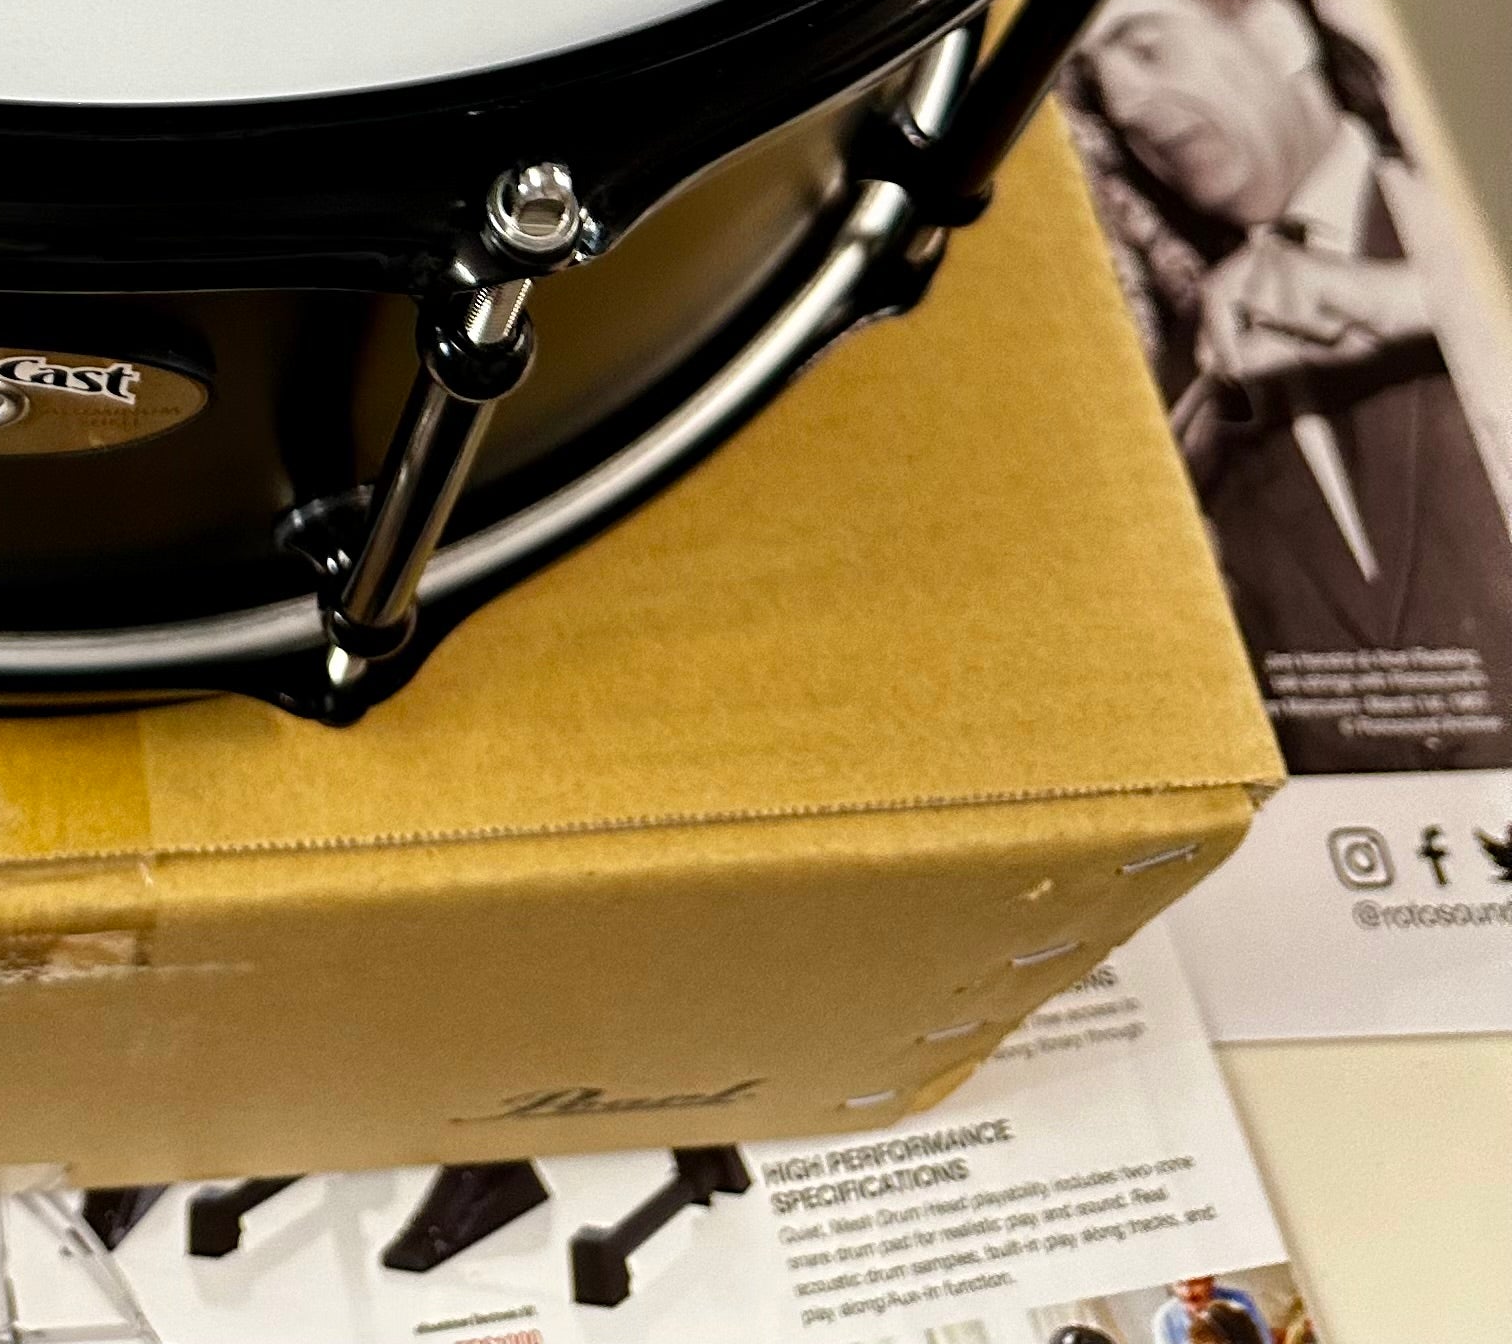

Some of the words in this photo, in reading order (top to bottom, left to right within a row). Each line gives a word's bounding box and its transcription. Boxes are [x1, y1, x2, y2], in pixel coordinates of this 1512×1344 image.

[762, 1155, 826, 1187] HIGH
[825, 1118, 1015, 1174] PERFORMANCE
[771, 1157, 970, 1215] SPECIFICATIONS
